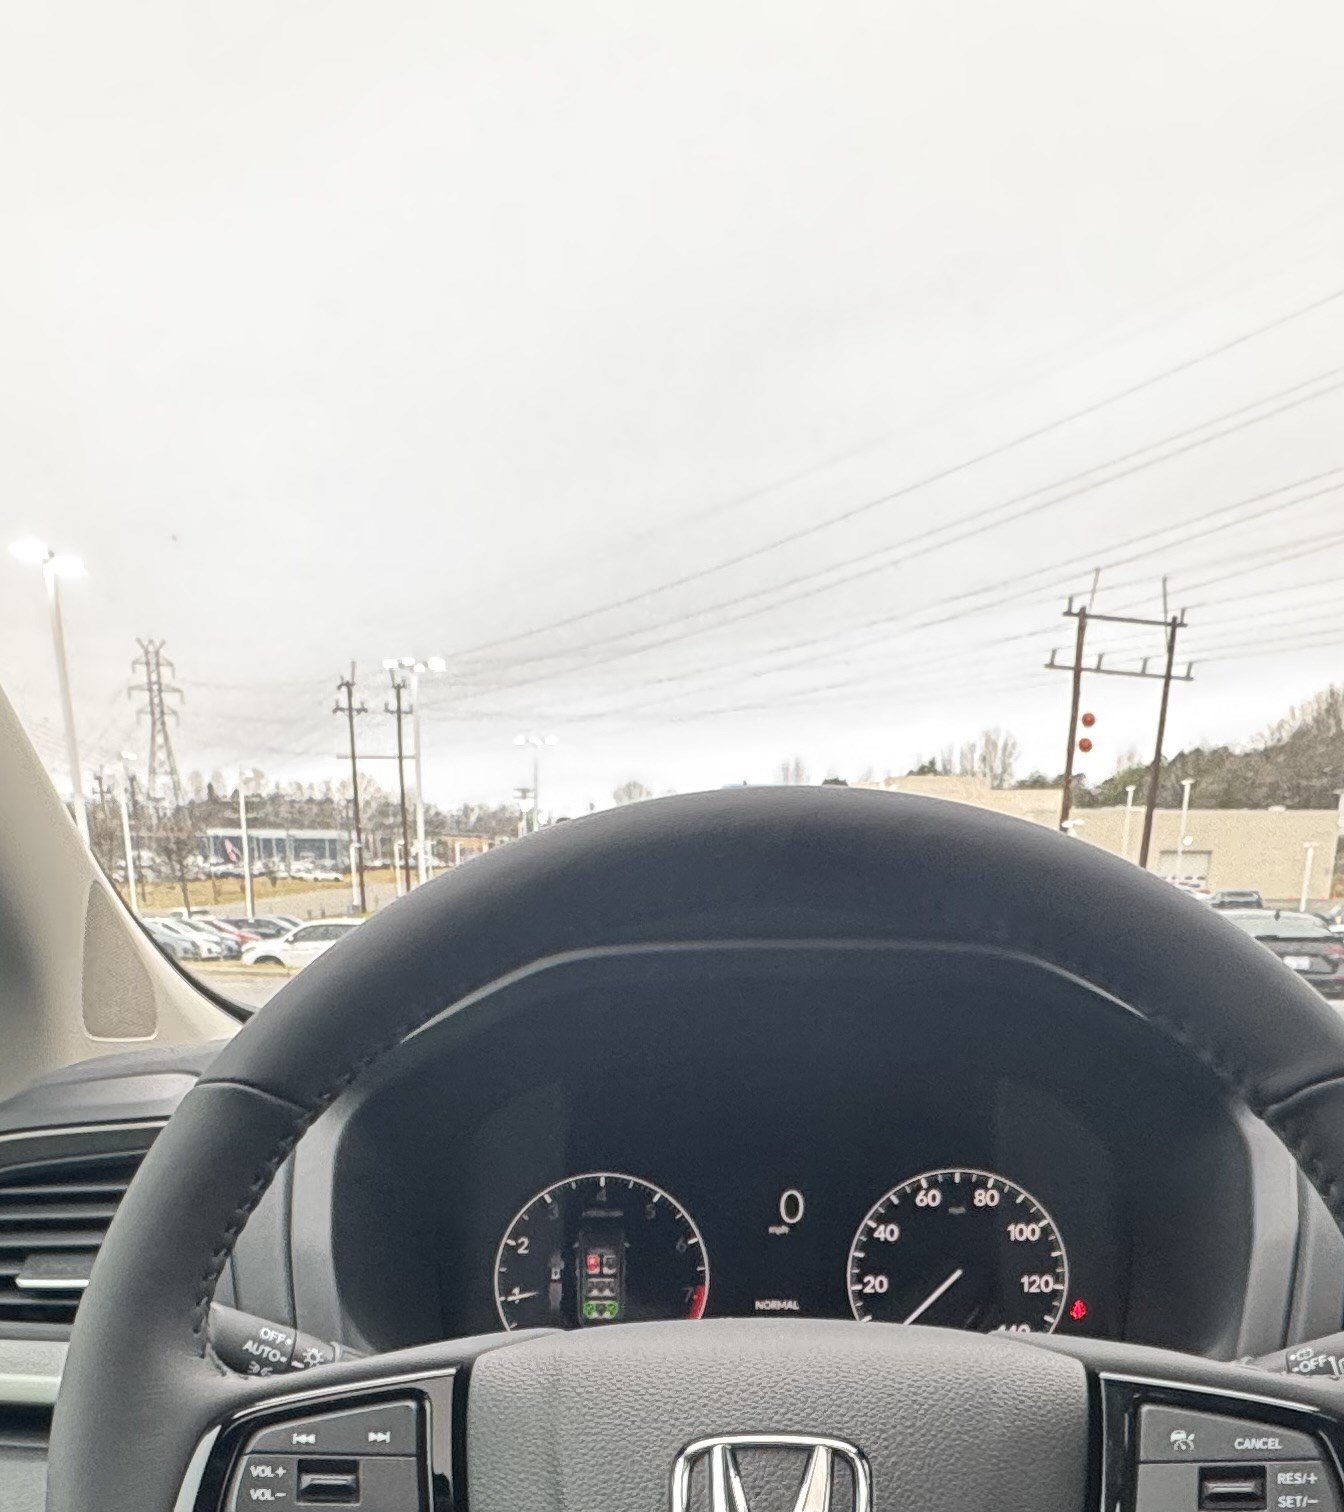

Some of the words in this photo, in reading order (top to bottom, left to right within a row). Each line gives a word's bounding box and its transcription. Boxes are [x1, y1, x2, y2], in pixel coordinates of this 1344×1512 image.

[779, 1189, 805, 1224] 0
[915, 1189, 942, 1208] 60
[973, 1189, 1000, 1208] 80
[872, 1223, 900, 1243] 40
[1006, 1223, 1040, 1242] 100
[516, 1236, 529, 1254] 2
[862, 1275, 889, 1294] 20
[1020, 1275, 1054, 1294] 120
[755, 1299, 800, 1311] NORMAL
[260, 1327, 287, 1345] OFF
[242, 1339, 282, 1363] AUTO
[1298, 1354, 1328, 1373] OFF
[1234, 1437, 1283, 1450] CANCEL
[1277, 1472, 1318, 1485] RES/+
